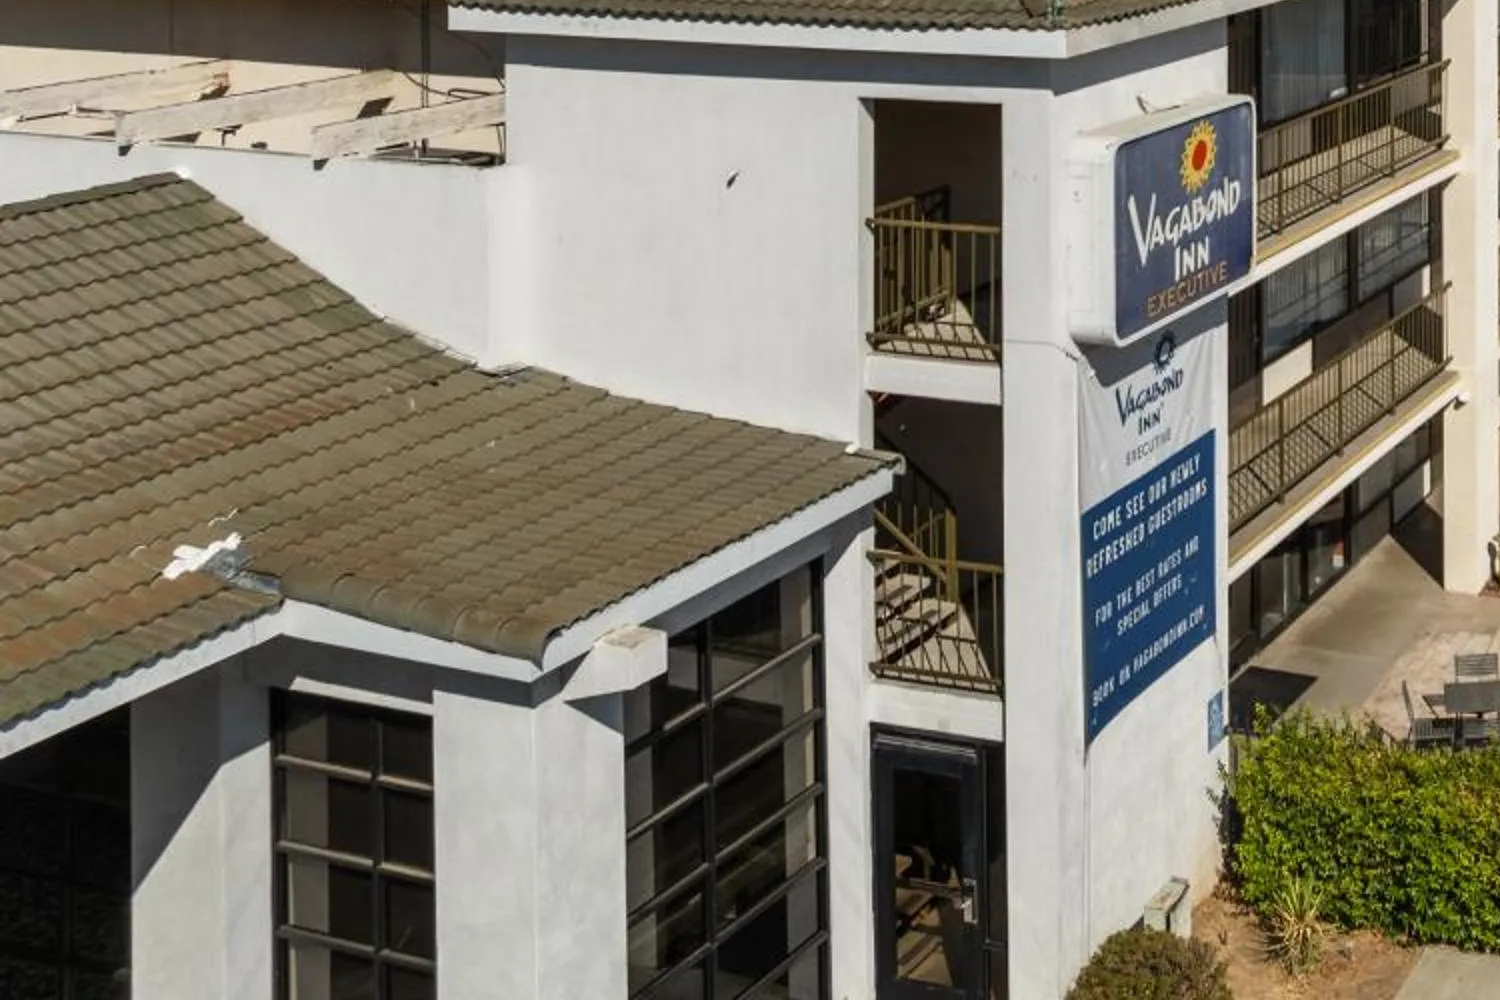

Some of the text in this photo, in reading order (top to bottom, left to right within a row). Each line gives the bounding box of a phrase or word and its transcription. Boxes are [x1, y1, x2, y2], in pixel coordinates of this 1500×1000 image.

[1127, 176, 1240, 268] VAGABOND
[1174, 236, 1210, 281] INN
[1147, 260, 1230, 316] EXECUTIVE
[1115, 368, 1183, 428] VAGABOND
[1138, 408, 1161, 435] INN
[1093, 452, 1201, 541] COME SEE OUR NEWLY
[1086, 477, 1207, 579] REFRESHED GUESTROOMS
[1095, 535, 1199, 628] FOR THE BEST RATES AND
[1117, 599, 1150, 636] SPECIAL
[1092, 675, 1115, 707] BOOK
